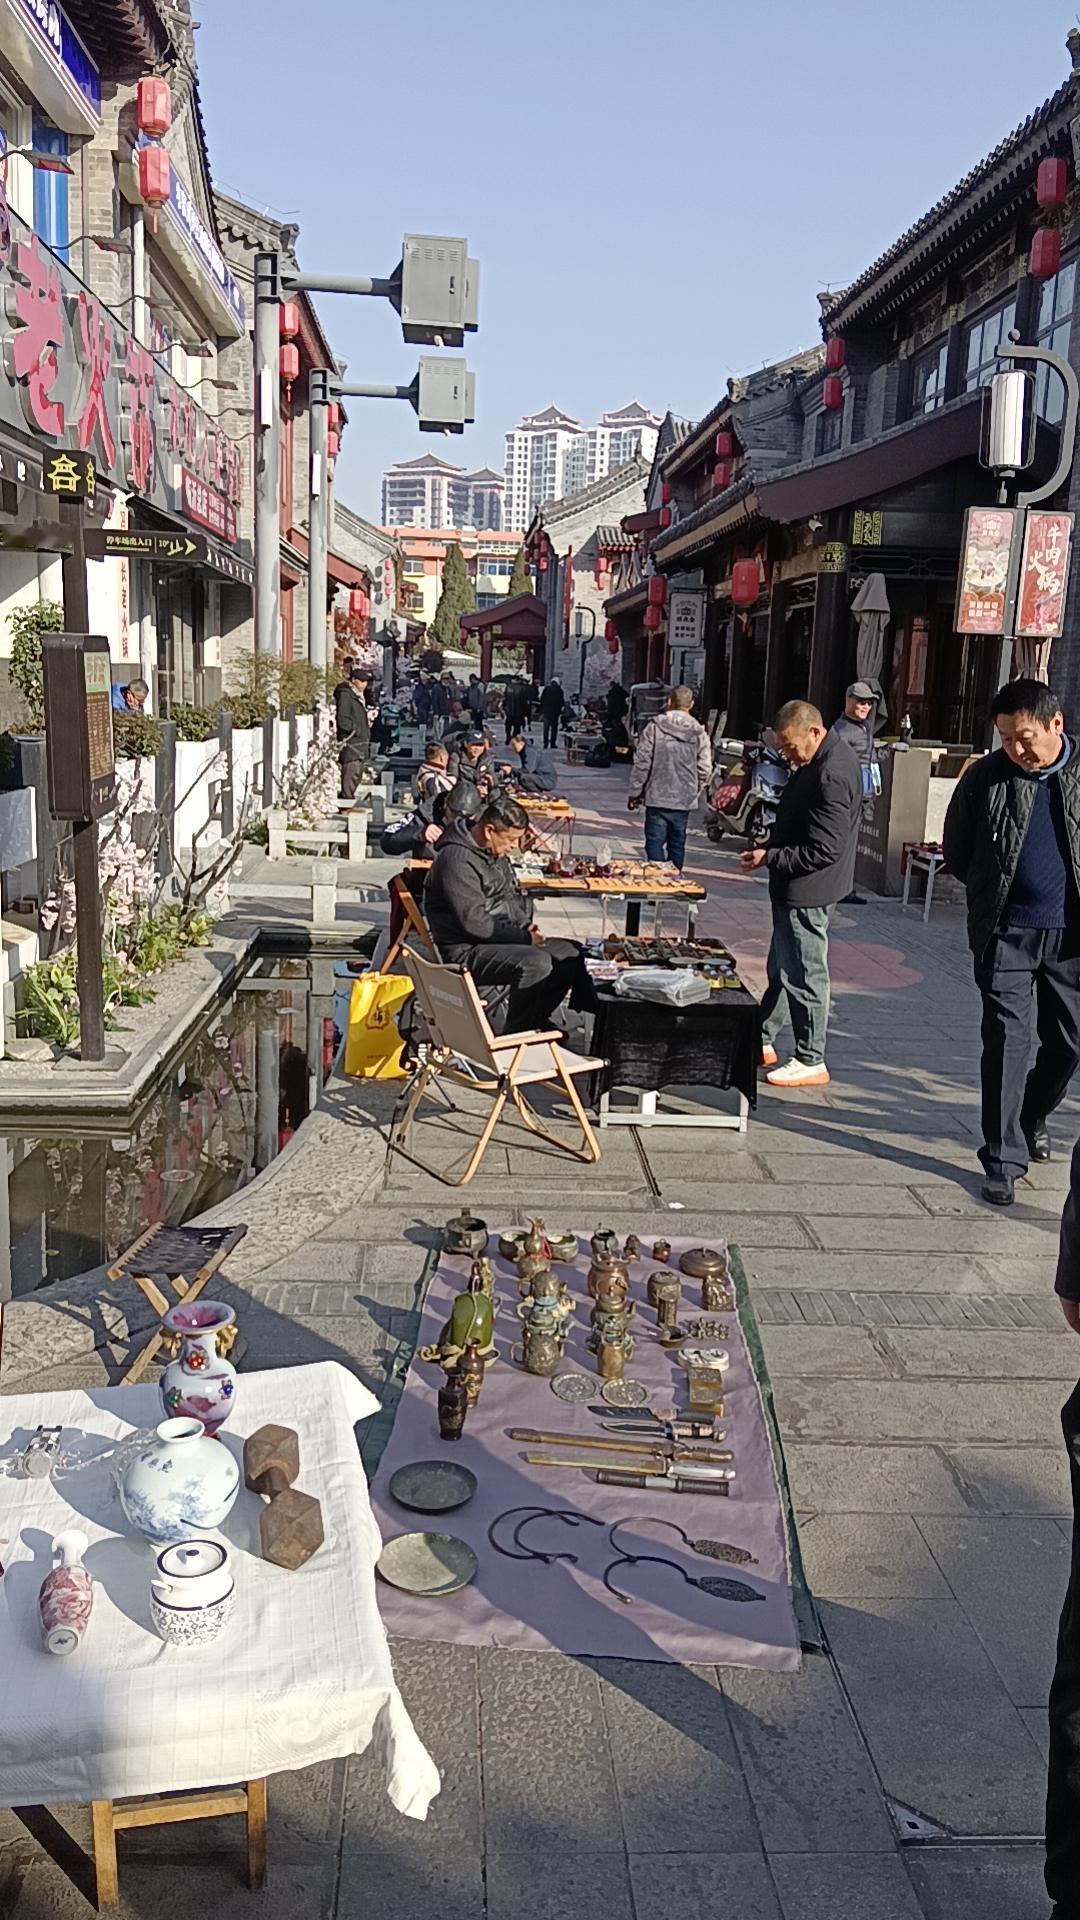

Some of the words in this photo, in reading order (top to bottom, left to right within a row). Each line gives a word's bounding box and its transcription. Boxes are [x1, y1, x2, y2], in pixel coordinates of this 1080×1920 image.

[106, 536, 152, 546] 停车场出入口
